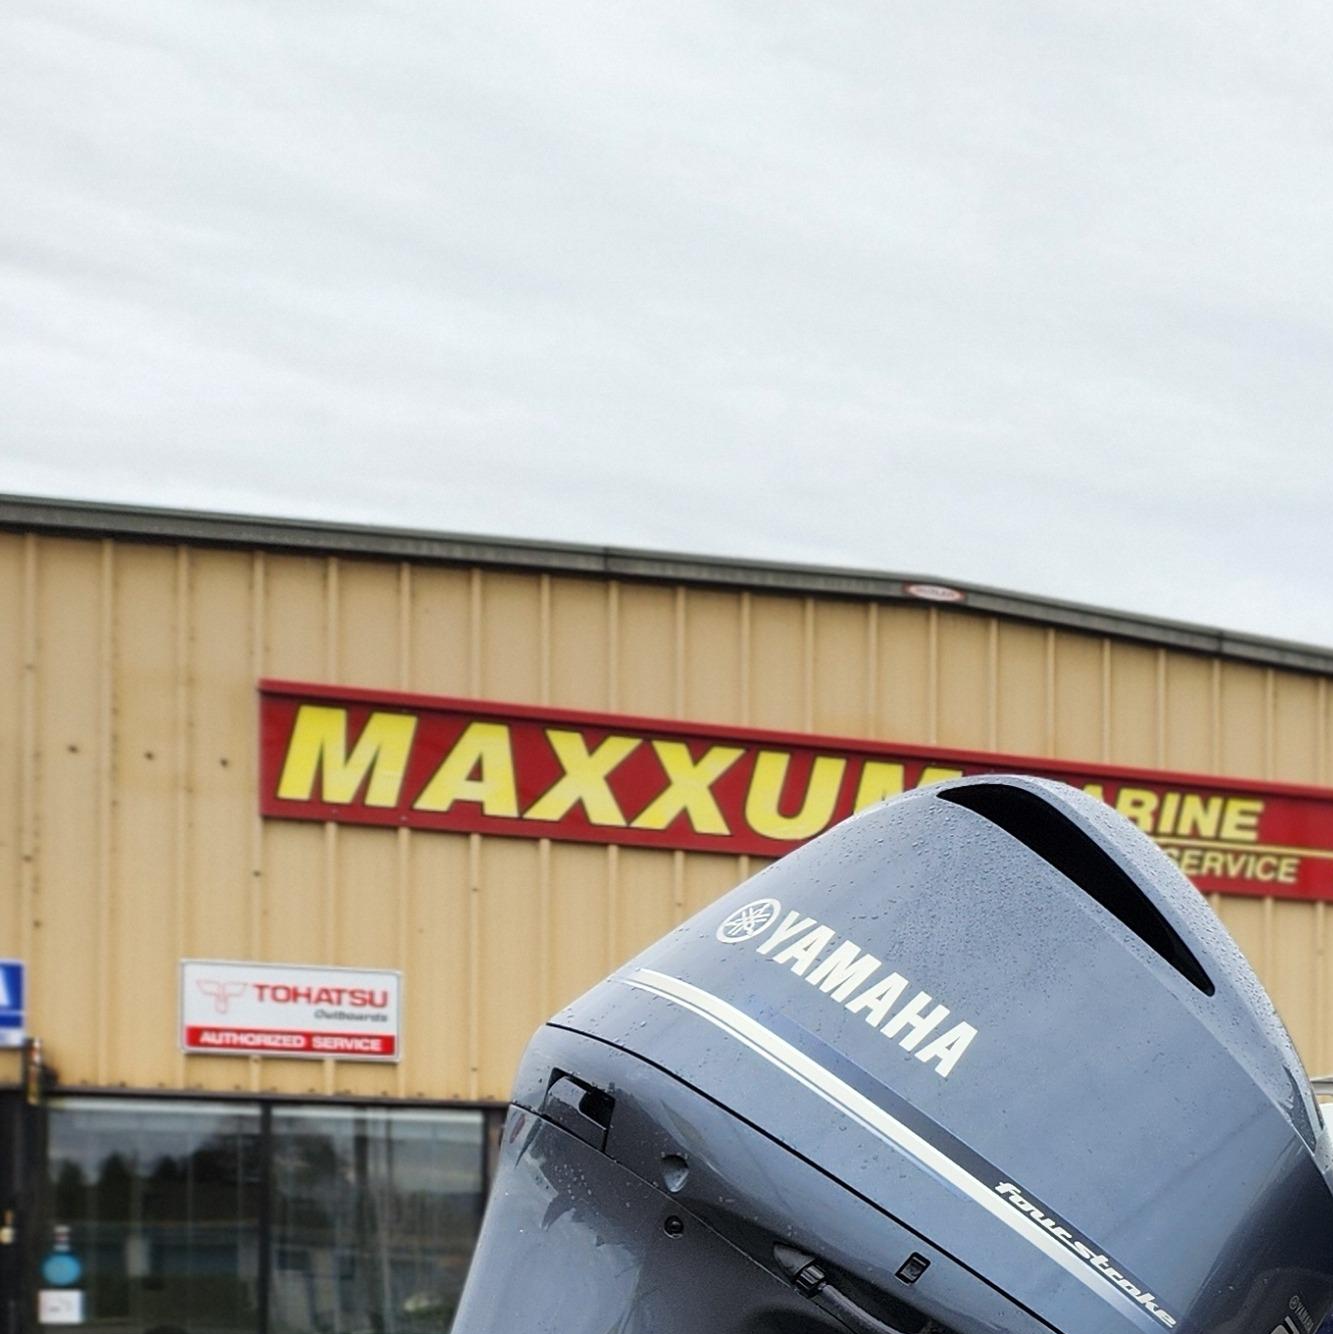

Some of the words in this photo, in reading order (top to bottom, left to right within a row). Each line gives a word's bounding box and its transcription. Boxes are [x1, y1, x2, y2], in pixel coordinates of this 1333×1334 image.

[1083, 784, 1264, 842] RINE
[253, 984, 388, 1009] TOHATSU
[756, 910, 978, 1078] YAMAHA
[314, 1009, 388, 1023] Outboards
[199, 1031, 306, 1049] AUTHORIZED
[312, 1036, 382, 1052] SERVICE
